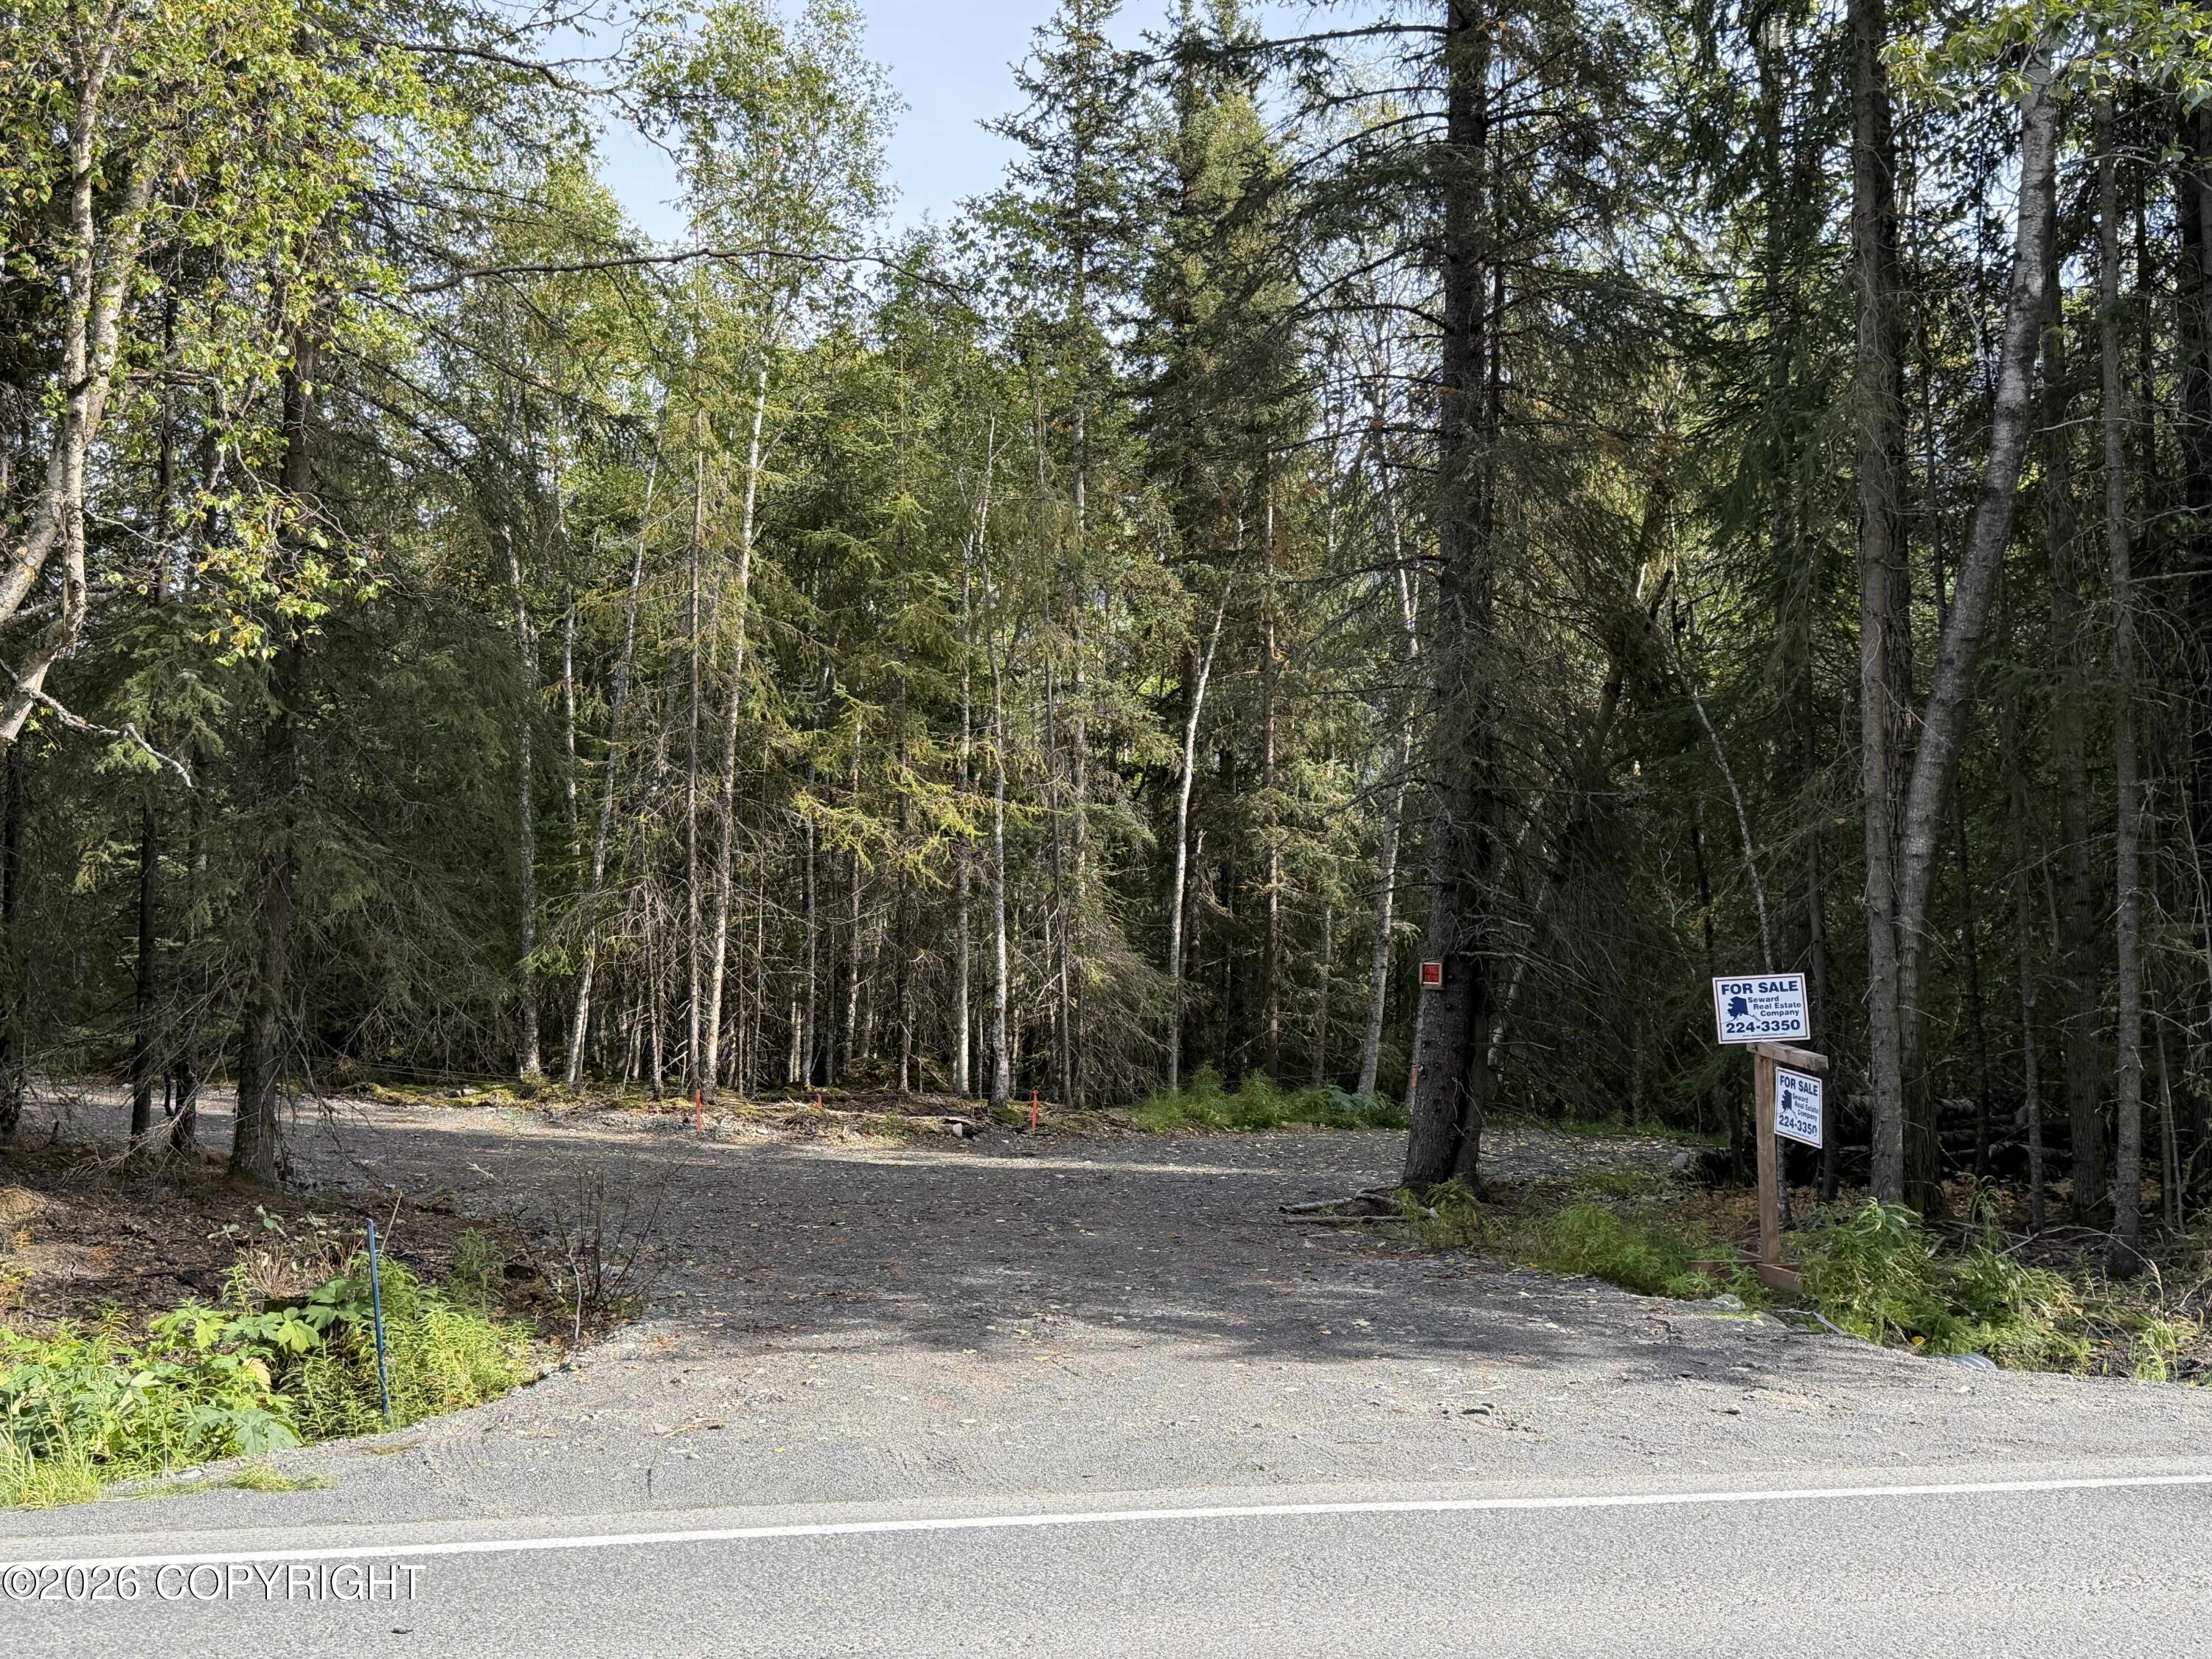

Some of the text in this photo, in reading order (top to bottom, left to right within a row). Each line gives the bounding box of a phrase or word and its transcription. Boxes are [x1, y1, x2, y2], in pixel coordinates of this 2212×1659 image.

[1722, 981, 1798, 995] FOR SALE
[1726, 1019, 1801, 1034] 224-3350
[1780, 1075, 1818, 1096] FOR SALE
[1792, 1093, 1809, 1102] Seward
[1795, 1101, 1818, 1114] Real Estate
[1798, 1108, 1817, 1122] Company
[1778, 1114, 1818, 1136] 224-3350
